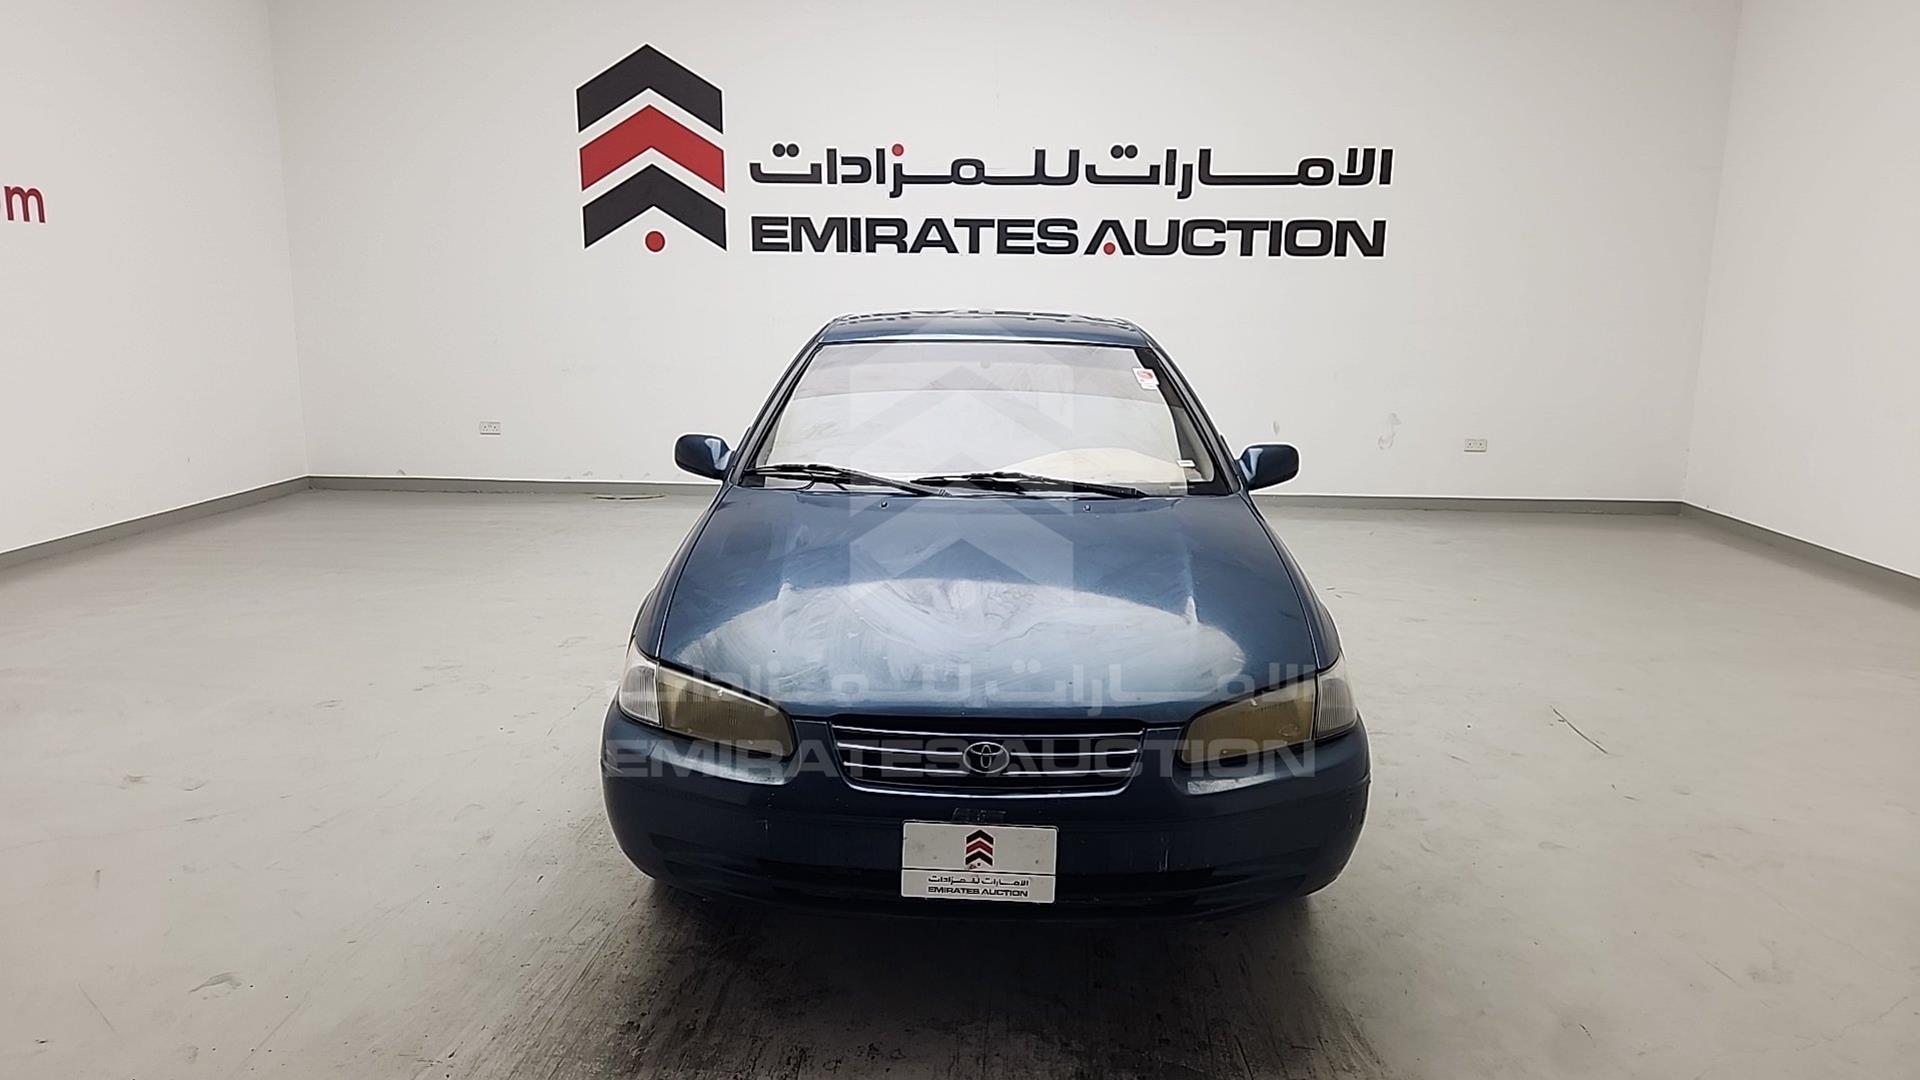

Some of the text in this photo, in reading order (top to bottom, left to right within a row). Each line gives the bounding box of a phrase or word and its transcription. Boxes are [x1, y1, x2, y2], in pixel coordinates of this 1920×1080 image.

[749, 143, 1394, 200] الامارات للمزادات
[0, 185, 46, 223] m
[750, 215, 1387, 258] EMIRATES AUCTION
[927, 886, 1028, 897] EMIRATES AUCTION
